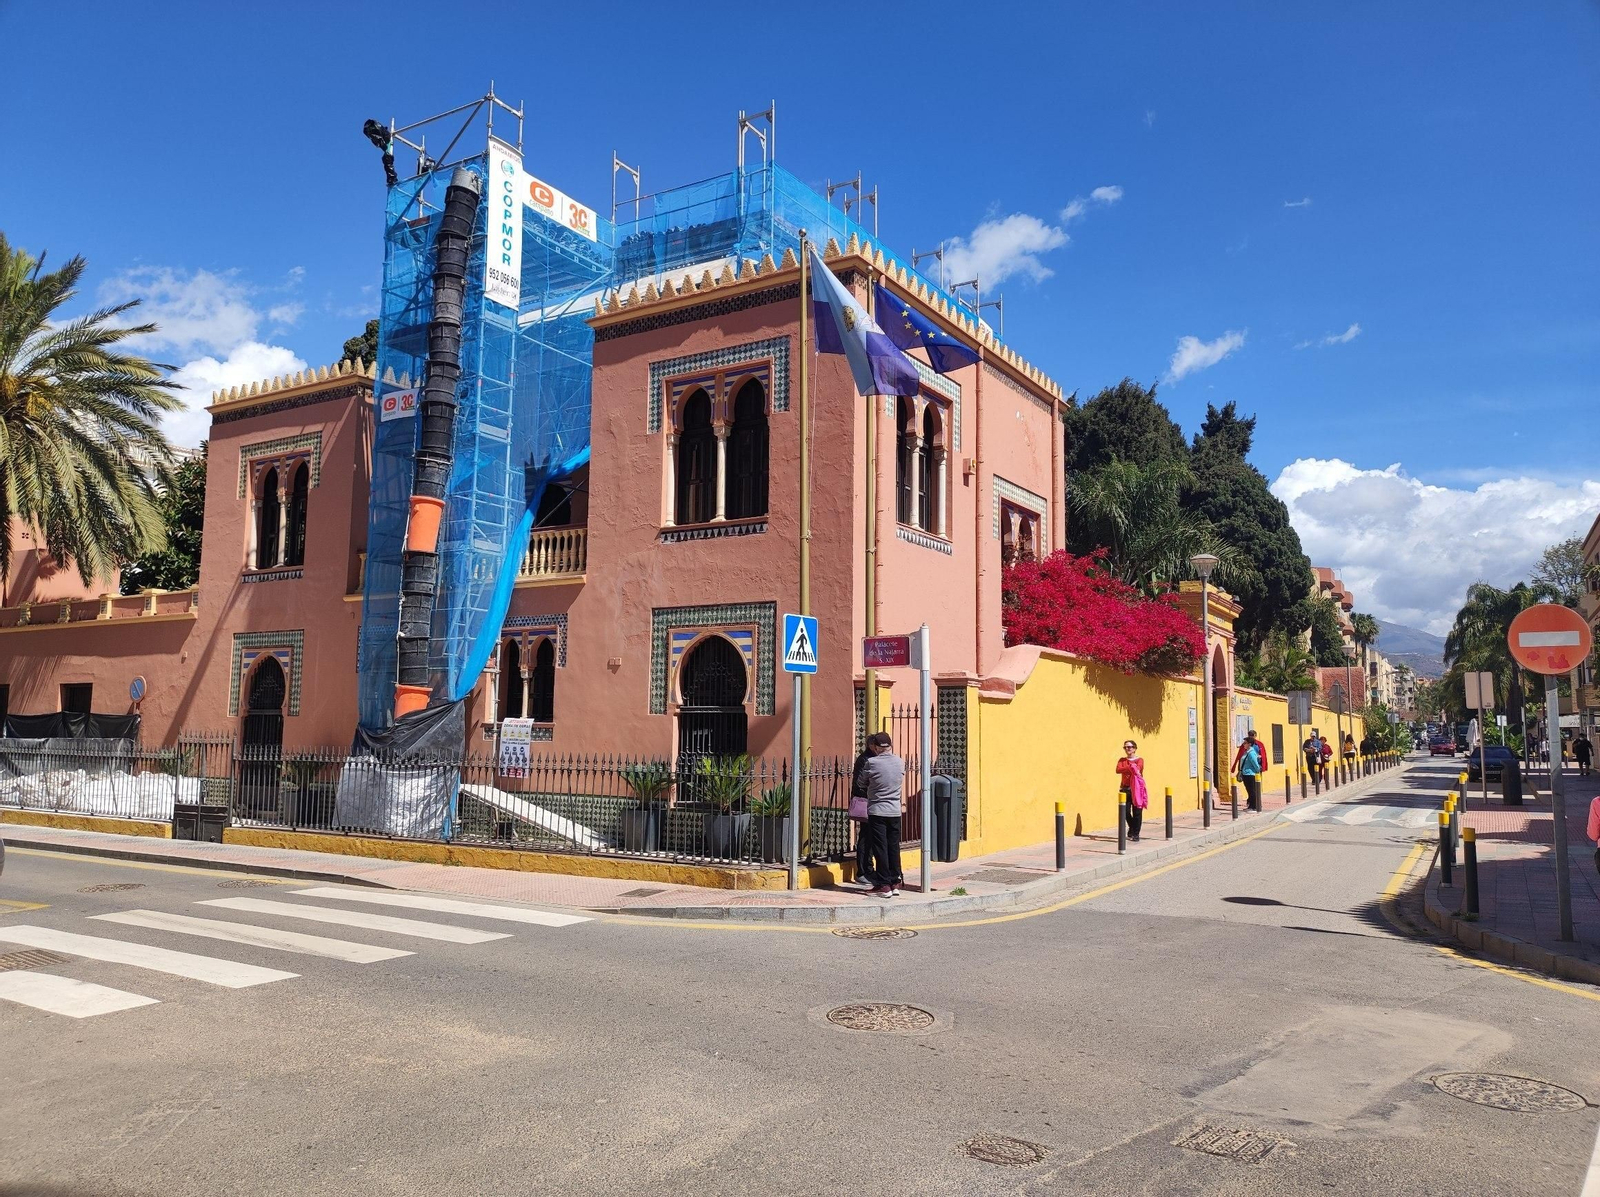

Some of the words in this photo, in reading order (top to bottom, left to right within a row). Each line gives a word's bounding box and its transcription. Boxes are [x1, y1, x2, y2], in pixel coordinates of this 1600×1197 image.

[502, 181, 513, 266] COPMOR
[569, 203, 587, 229] 3C
[489, 267, 500, 281] 952
[500, 272, 510, 286] 056
[401, 394, 414, 411] 3C
